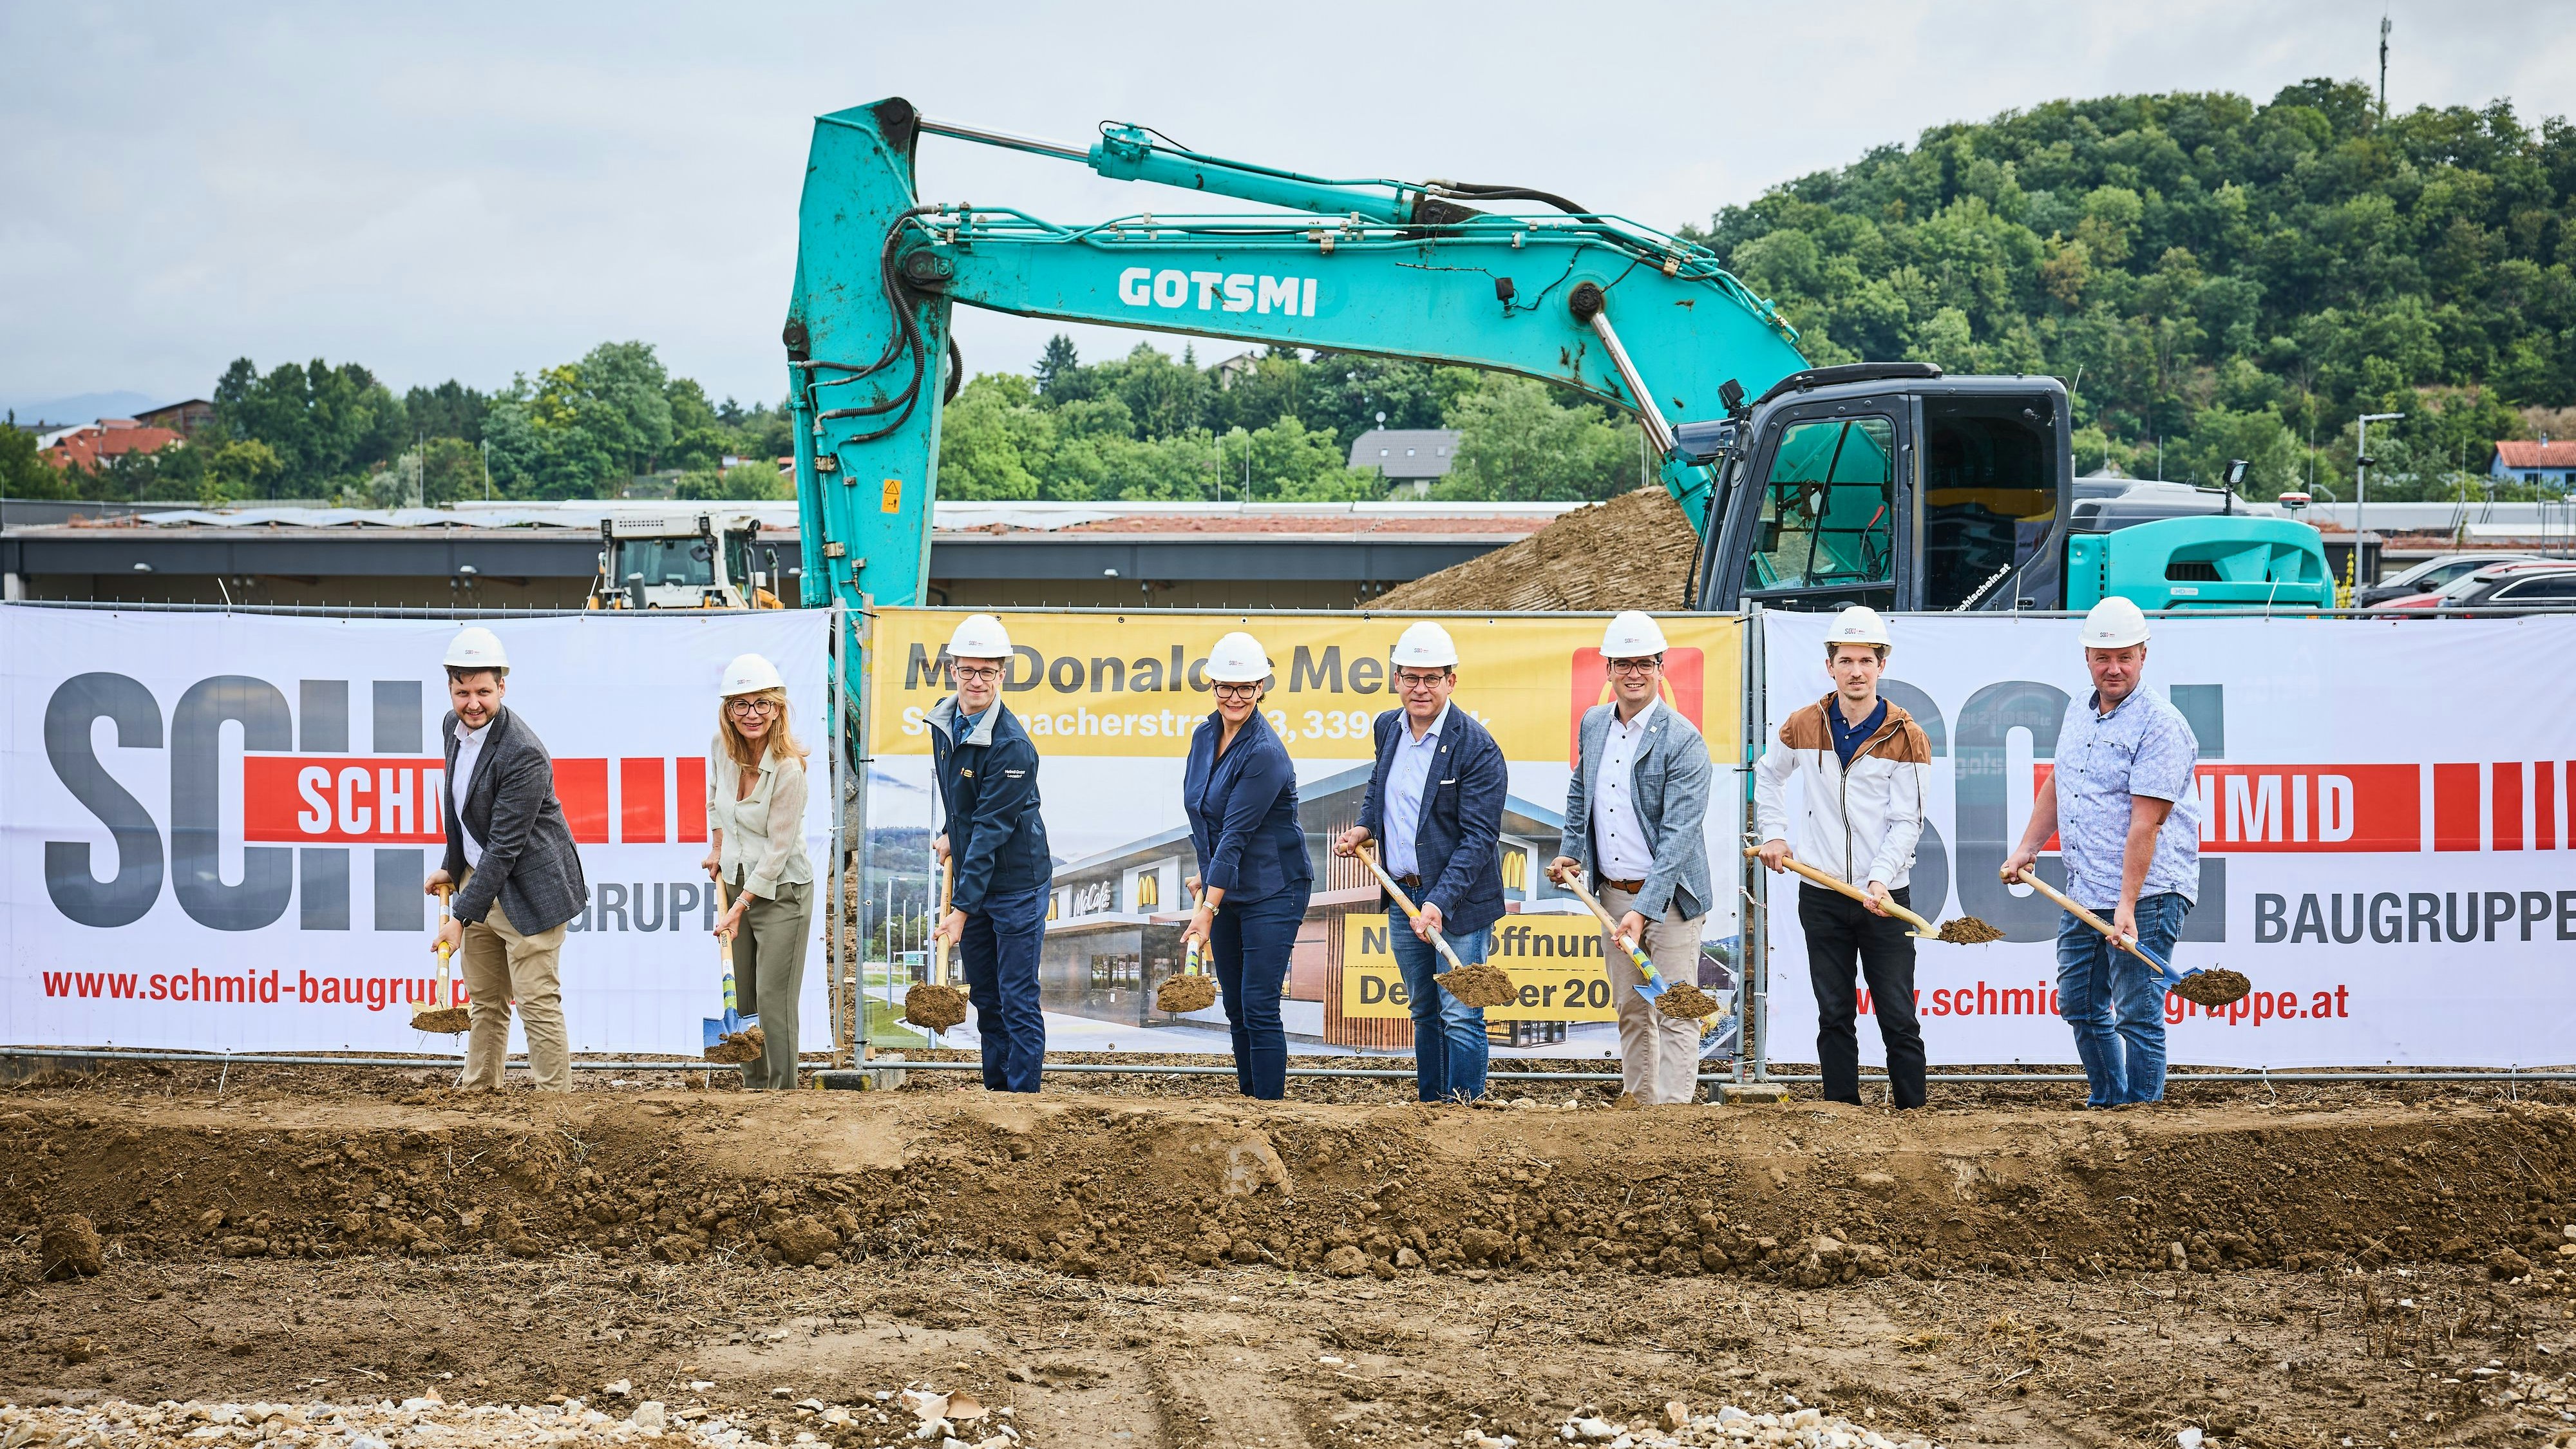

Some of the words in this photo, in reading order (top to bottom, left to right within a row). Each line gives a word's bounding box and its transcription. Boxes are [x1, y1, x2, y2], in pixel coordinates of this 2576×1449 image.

[1119, 267, 1318, 317] GOTSMI
[904, 643, 1276, 694] MDonal
[1288, 645, 1399, 694] Mel
[1302, 710, 1379, 739] 339
[297, 766, 446, 835] SCH
[2198, 774, 2354, 842] MID
[567, 882, 717, 933] GRUPP
[2255, 891, 2576, 944] BAUGRUPPE
[1359, 976, 1557, 1008] Deer
[1564, 978, 1615, 1009] 20
